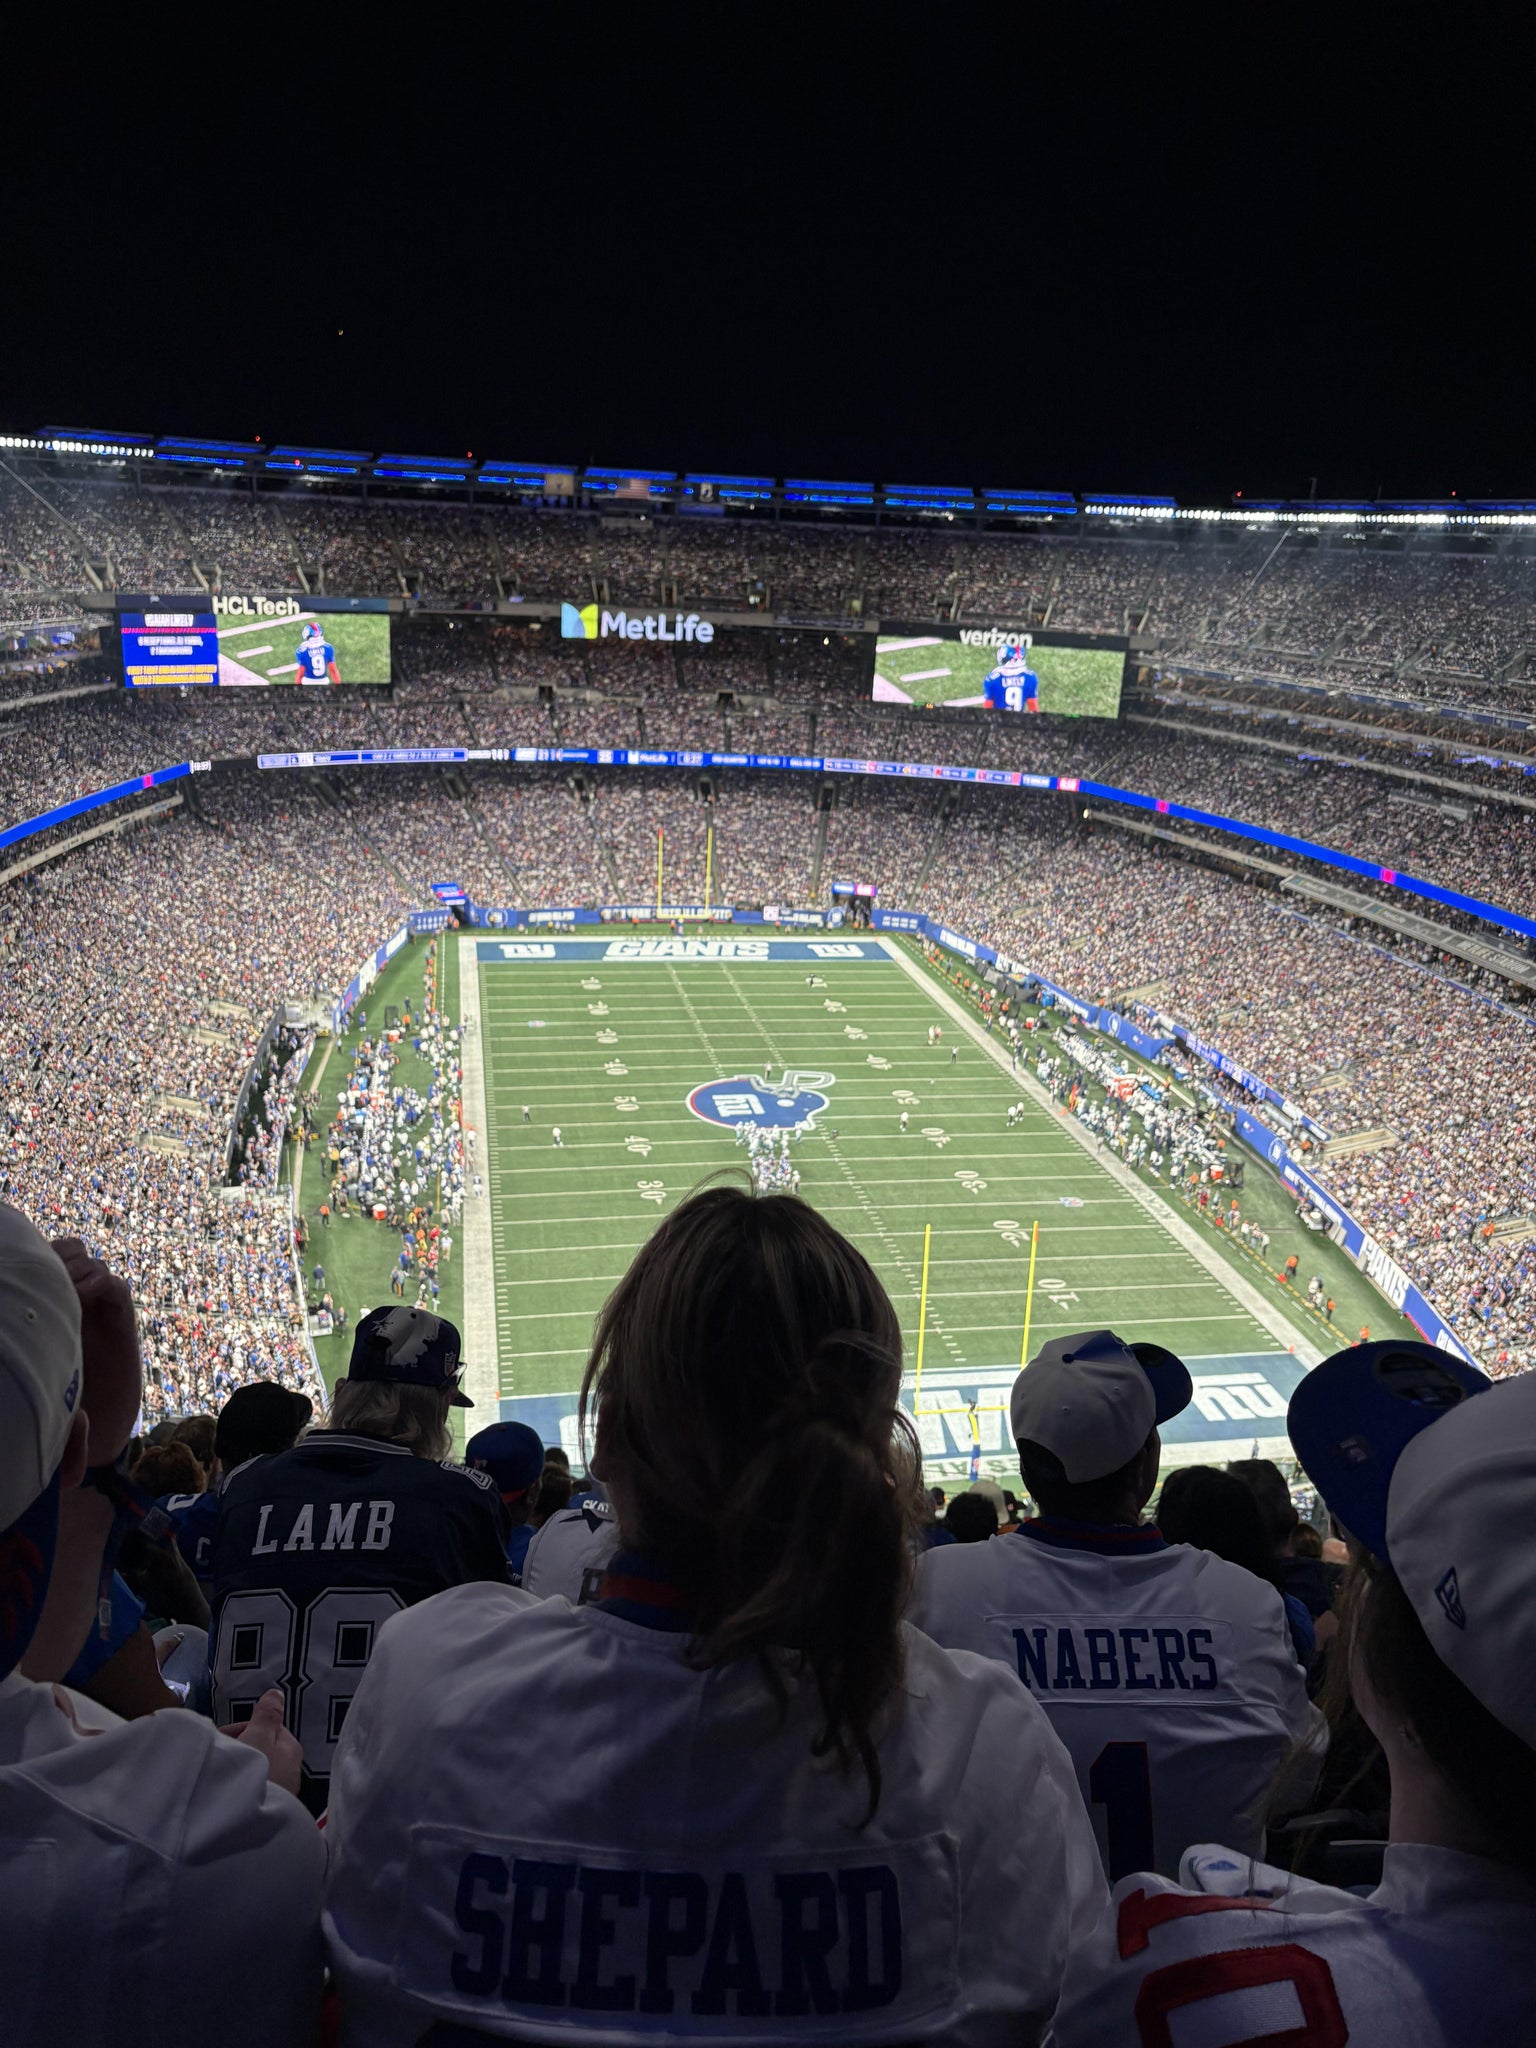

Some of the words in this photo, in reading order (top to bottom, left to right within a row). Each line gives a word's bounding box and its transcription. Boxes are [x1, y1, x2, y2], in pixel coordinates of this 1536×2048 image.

[212, 596, 300, 616] HCLTech
[601, 611, 714, 643] MetLife
[960, 627, 1033, 648] verizon
[310, 656, 326, 677] 9
[1005, 686, 1023, 712] 9
[604, 940, 769, 957] GIANTS
[613, 1095, 639, 1112] 50
[891, 1089, 920, 1105] 50
[624, 1135, 652, 1152] 40
[637, 1180, 667, 1200] 30
[954, 1170, 988, 1191] 30
[993, 1219, 1030, 1244] 20
[1037, 1278, 1080, 1307] 10
[251, 1500, 396, 1556] LAMB
[1012, 1628, 1218, 1691] NABERS
[213, 1587, 409, 1780] 88
[450, 1851, 902, 2017] SHEPARD
